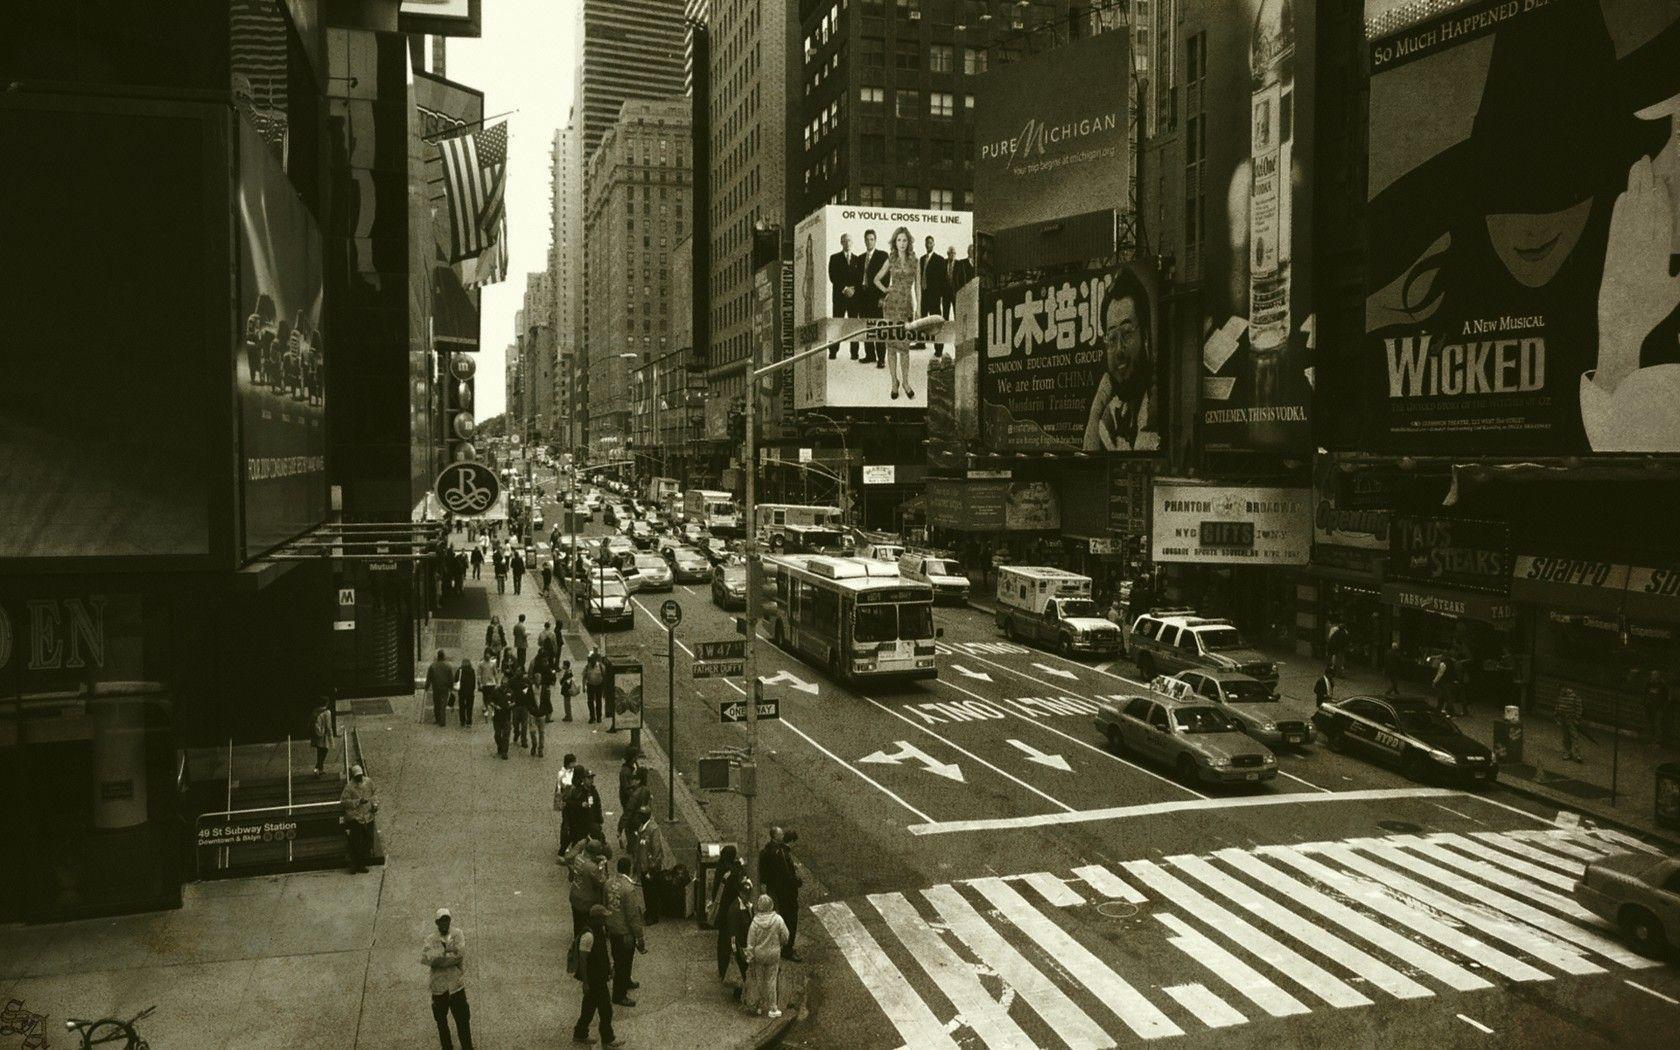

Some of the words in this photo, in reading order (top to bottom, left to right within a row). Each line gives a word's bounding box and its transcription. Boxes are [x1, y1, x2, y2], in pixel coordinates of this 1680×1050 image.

[1374, 46, 1392, 66] SO
[1396, 32, 1437, 58] MUCH
[1440, 1, 1519, 43] HAPPENED
[1523, 0, 1550, 13] BE
[982, 138, 1017, 159] PURE
[1006, 113, 1116, 170] MICHIGAN
[842, 210, 856, 220] OR
[858, 211, 889, 222] YOU'LL
[890, 213, 920, 223] CROSS
[921, 214, 938, 224] THE
[940, 215, 962, 225] LINE.
[1463, 321, 1471, 336] A
[1474, 319, 1499, 334] NEW
[1500, 316, 1545, 332] MUSICAL
[988, 360, 1022, 374] SUNMOON
[1027, 353, 1071, 370] EDUCATION
[1075, 350, 1103, 364] GROUP
[998, 380, 1013, 393] We
[1015, 378, 1032, 391] are
[1032, 374, 1055, 391] from
[1057, 371, 1094, 388] CHINA
[1204, 408, 1248, 424] GENTLEMEN,
[1248, 407, 1266, 422] THIS
[1267, 406, 1275, 421] IS
[1275, 405, 1308, 421] VODKA.
[1163, 501, 1211, 513] PHANTOM
[1175, 528, 1197, 538] NYC
[1203, 522, 1251, 546] GIFTS
[369, 563, 398, 571] Mutual
[1430, 547, 1501, 577] STEAKS
[705, 645, 714, 656] W
[717, 643, 731, 656] 47
[693, 664, 718, 674] FATHER
[720, 663, 742, 673] DUFFY
[729, 704, 746, 718] ONE
[903, 700, 1005, 725] ONLY
[1374, 731, 1399, 748] NYPD
[197, 828, 210, 839] 49
[212, 826, 223, 837] St
[224, 825, 262, 836] Subway
[263, 821, 297, 832] Station
[197, 836, 235, 846] Downtown
